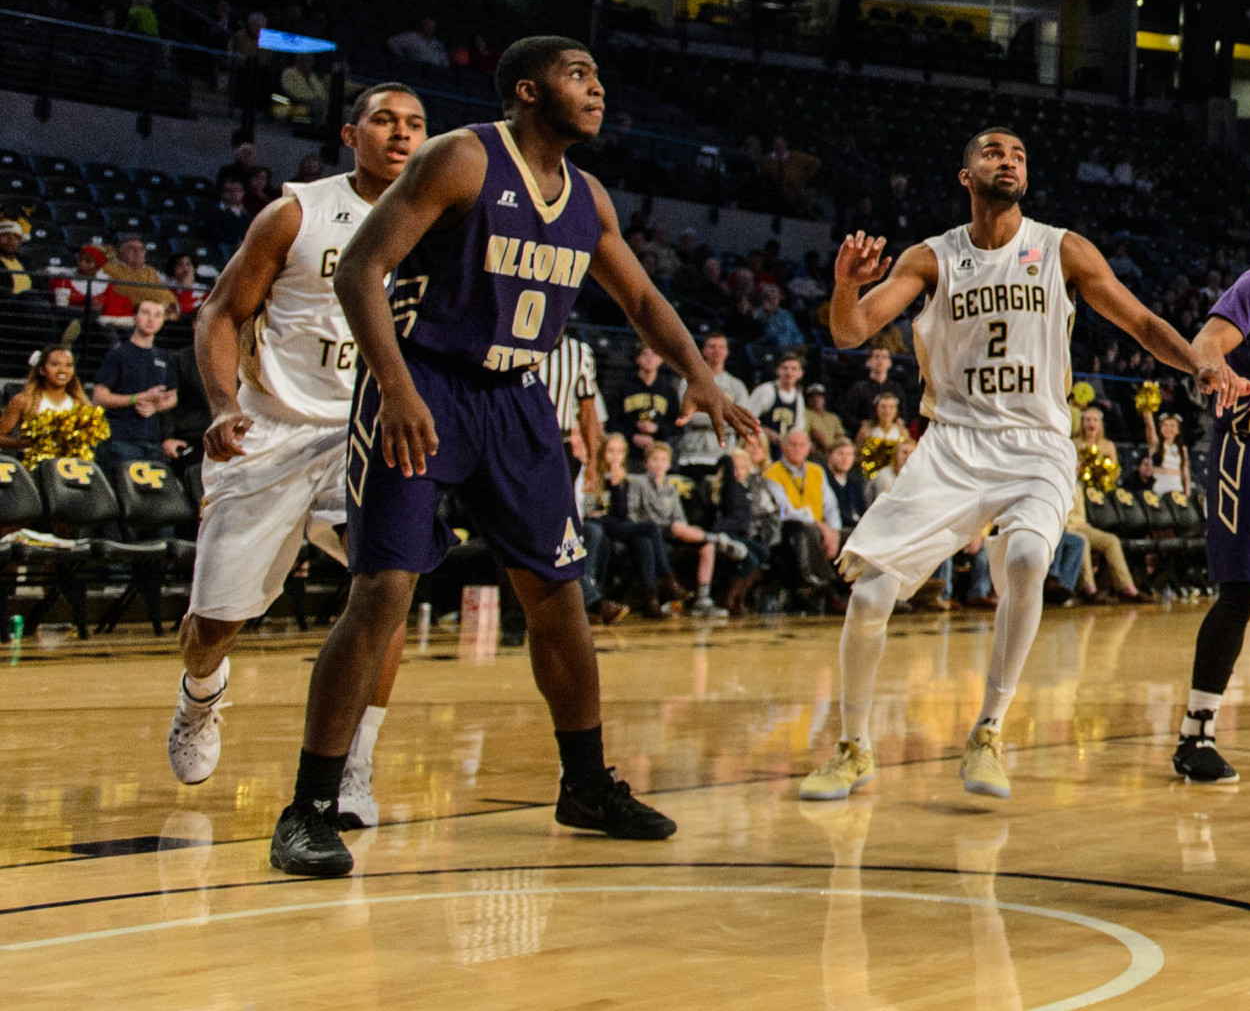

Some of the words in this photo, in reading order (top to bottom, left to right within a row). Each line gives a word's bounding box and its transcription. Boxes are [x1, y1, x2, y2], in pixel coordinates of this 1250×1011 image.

[484, 234, 591, 288] ALCORN
[512, 289, 546, 341] 0
[951, 283, 1047, 322] GEORGIA
[319, 338, 359, 371] TE
[986, 319, 1009, 360] 2
[964, 364, 1036, 396] TECH
[57, 457, 94, 485] GT
[129, 461, 166, 488] GT
